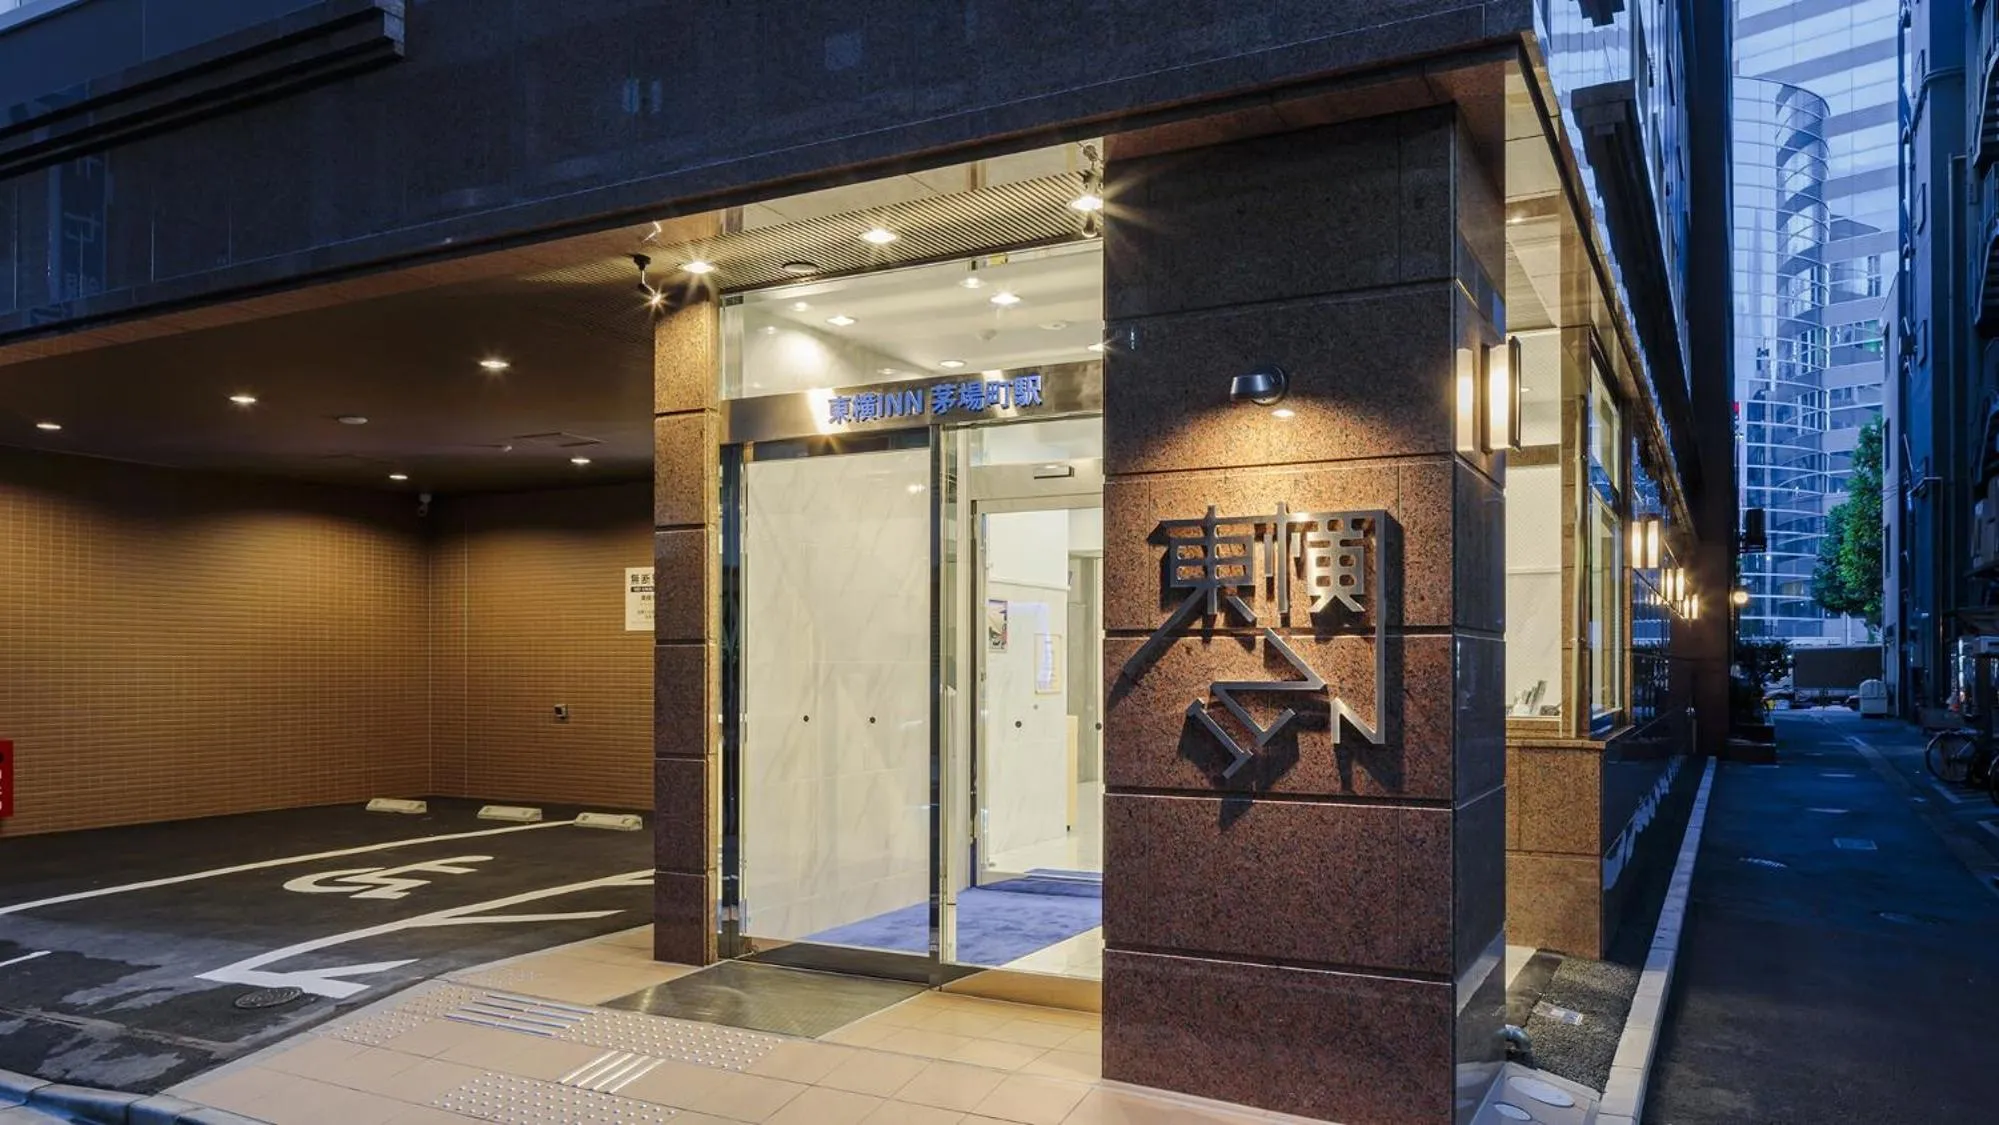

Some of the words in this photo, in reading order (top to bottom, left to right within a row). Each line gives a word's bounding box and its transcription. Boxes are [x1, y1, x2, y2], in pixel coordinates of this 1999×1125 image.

[828, 388, 925, 425] 東横INN
[931, 374, 1043, 415] 茅場町駅
